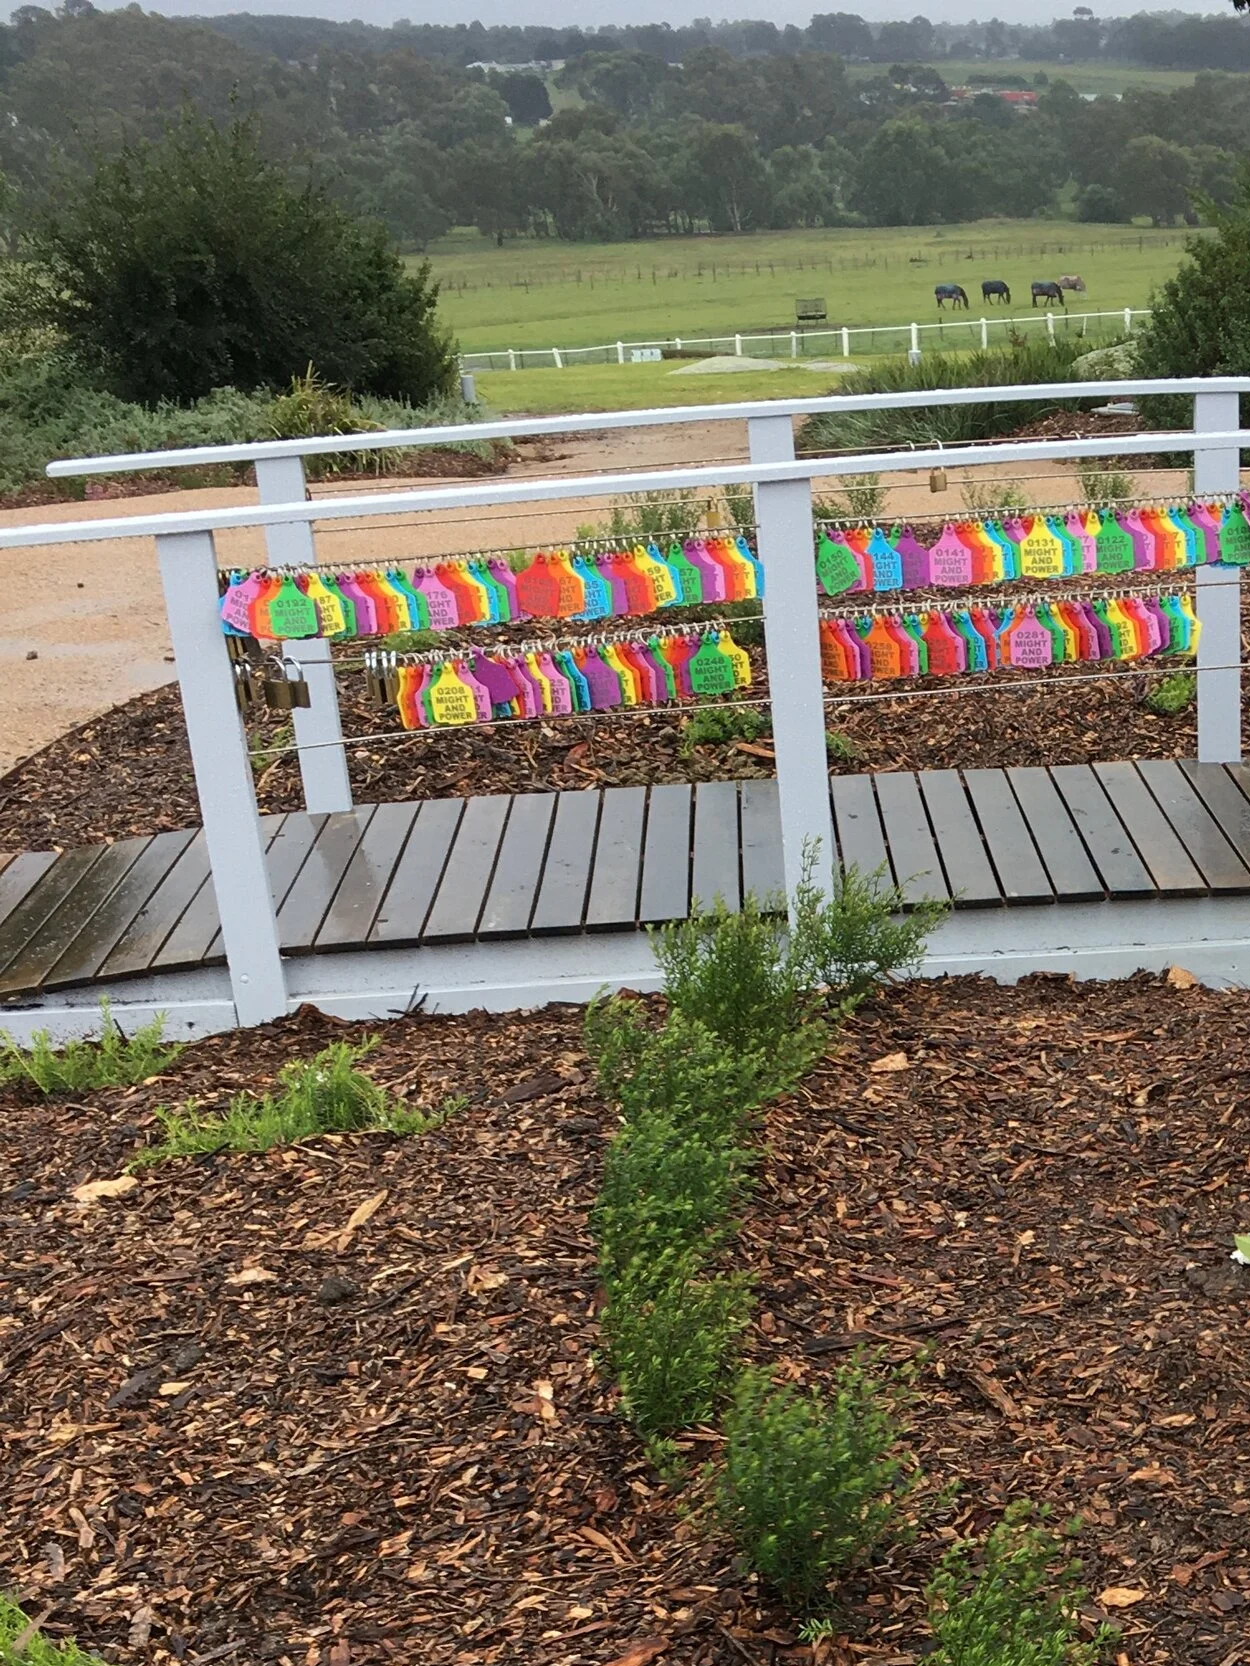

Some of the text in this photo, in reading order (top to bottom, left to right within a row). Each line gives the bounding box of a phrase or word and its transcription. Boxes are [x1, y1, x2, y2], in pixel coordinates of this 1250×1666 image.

[1024, 548, 1058, 556] MIGHT
[934, 558, 967, 566] MIGHT
[941, 566, 962, 574] AND
[1015, 640, 1047, 648] MIGHT
[1021, 648, 1042, 656] AND
[695, 666, 727, 674] MIGHT
[703, 674, 724, 682] AND
[697, 682, 730, 690] POWER
[445, 704, 465, 712] AND
[439, 712, 472, 720] POWER
